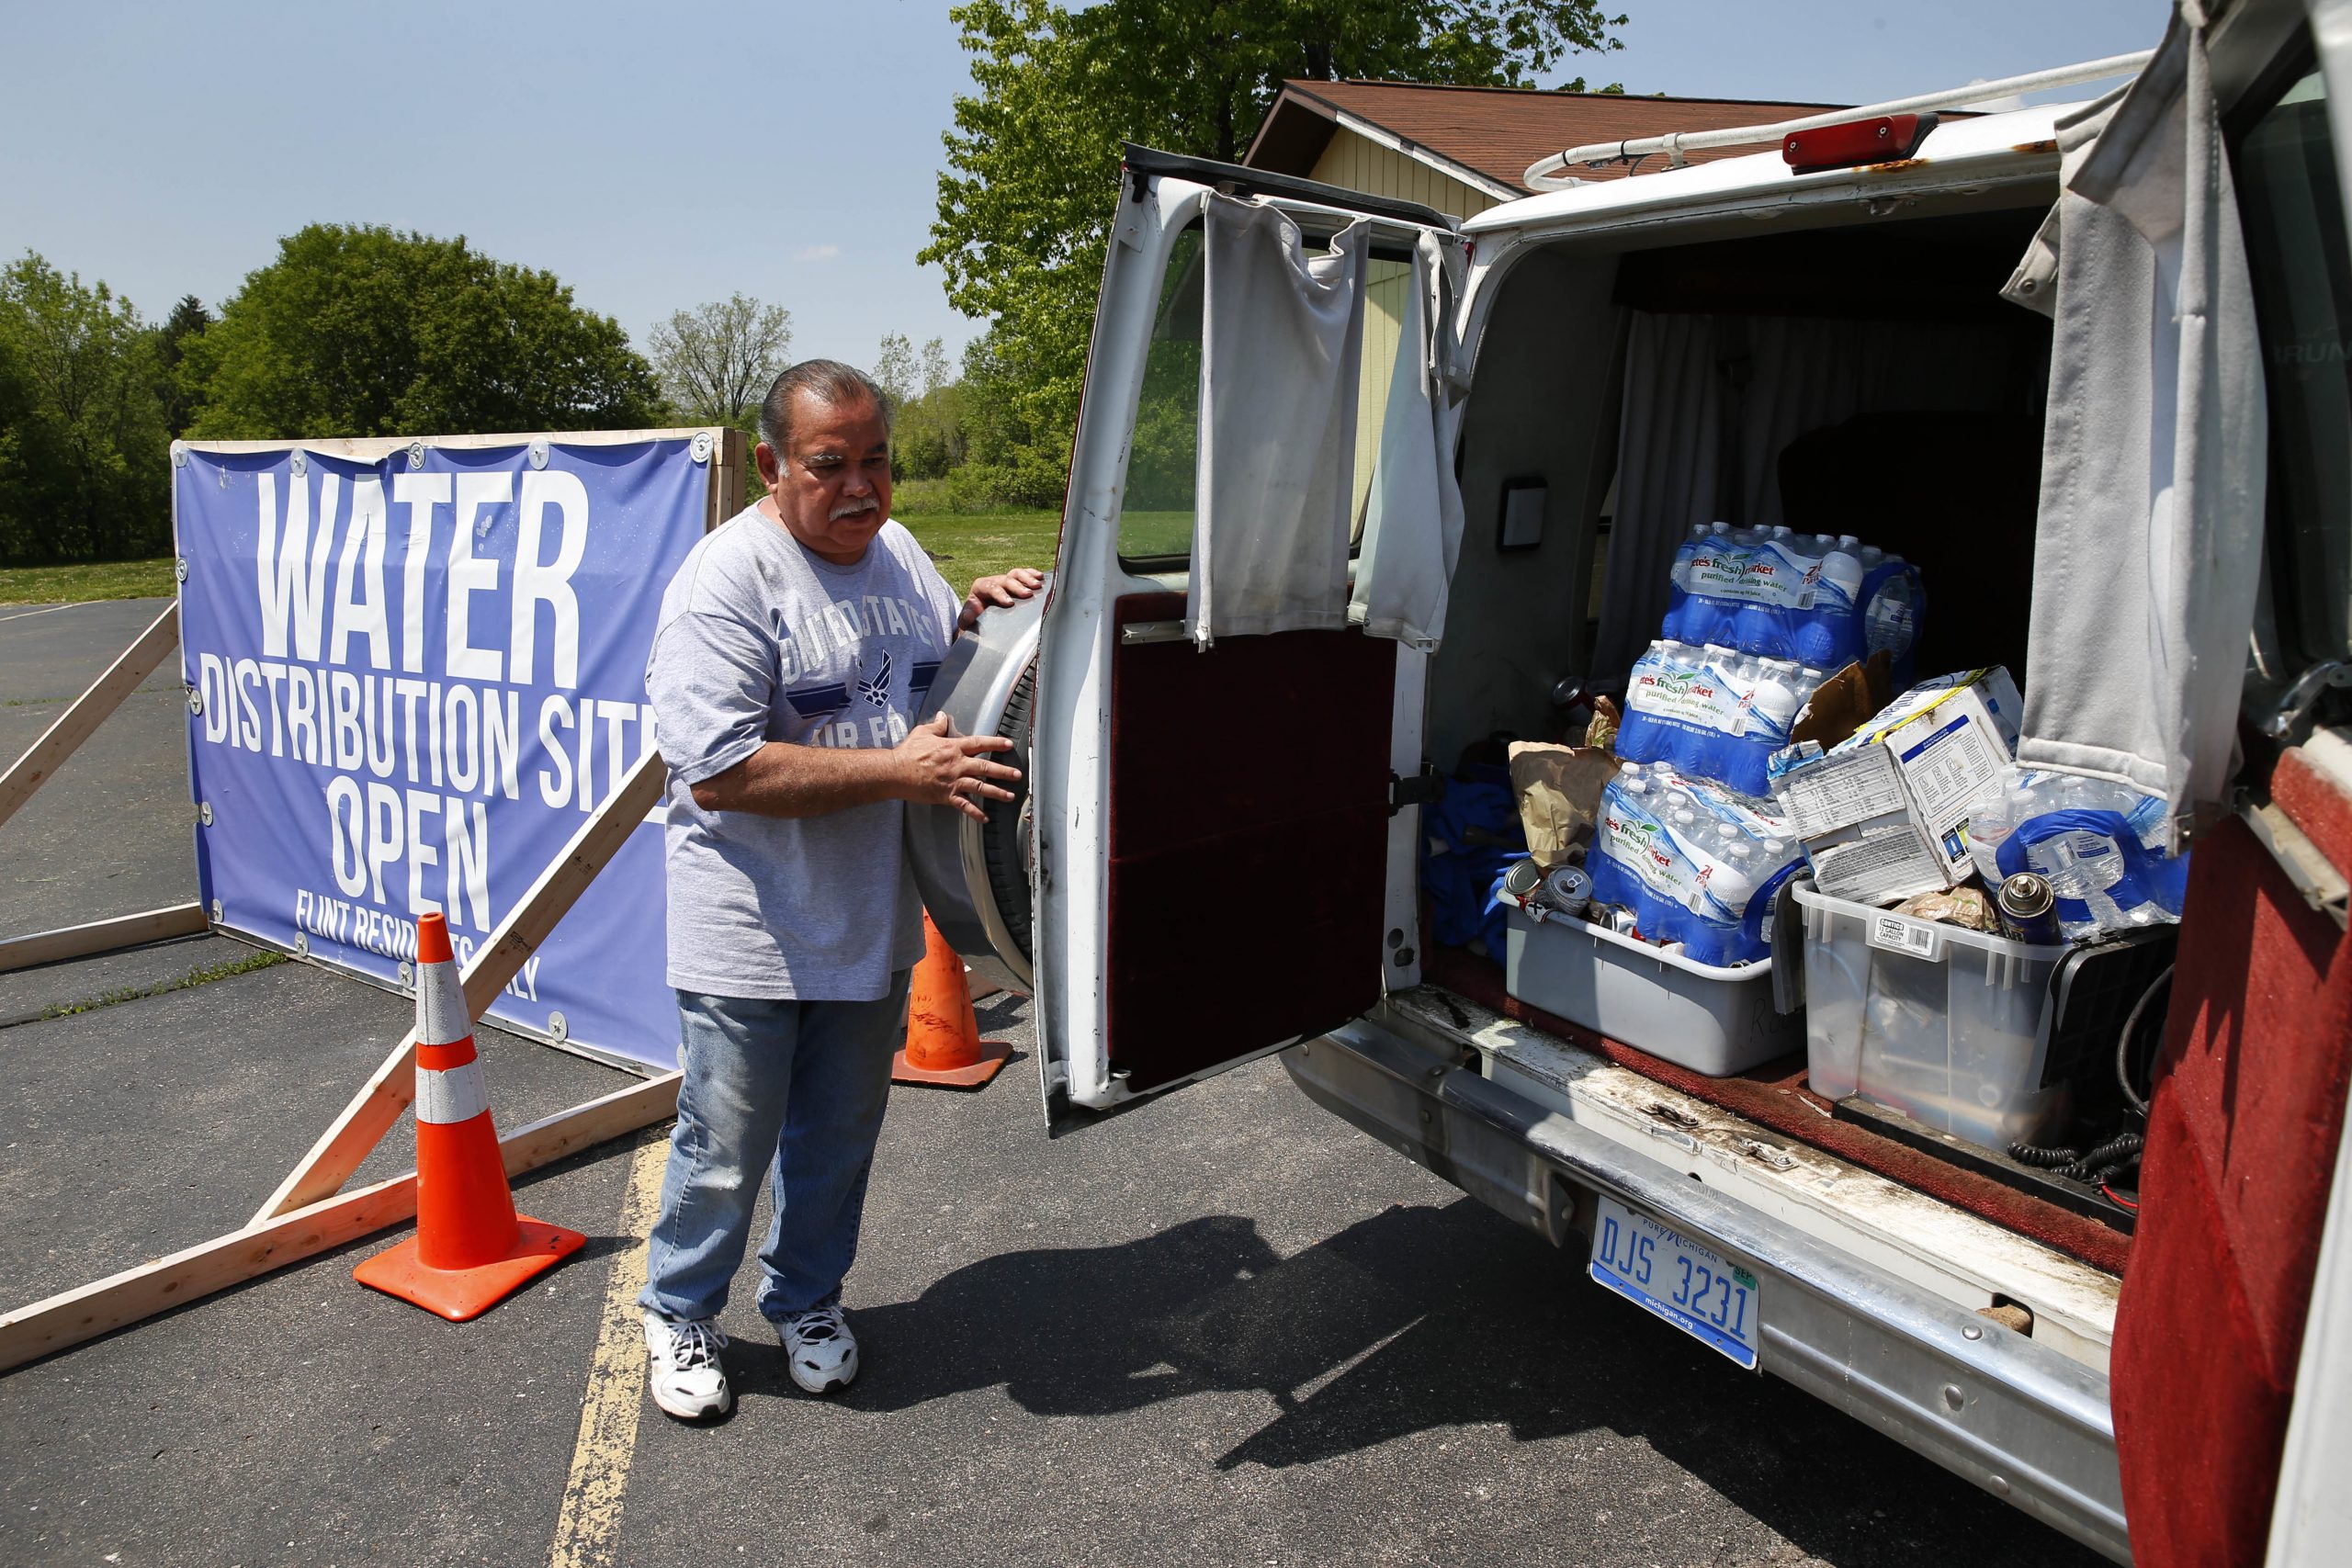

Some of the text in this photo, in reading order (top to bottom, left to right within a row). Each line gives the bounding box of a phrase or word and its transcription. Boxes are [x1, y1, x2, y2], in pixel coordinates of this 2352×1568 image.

[1713, 558, 1742, 575] fresh
[258, 470, 589, 690] WATER
[1701, 571, 1734, 583] purified
[1763, 580, 1788, 592] water
[1657, 677, 1685, 694] fresh
[1645, 690, 1677, 704] purified
[1702, 703, 1724, 716] water
[199, 653, 520, 801] DISTRIBUTION
[1621, 823, 1647, 848] fresh
[326, 775, 491, 933] OPEN
[1610, 835, 1639, 854] purified
[1658, 870, 1682, 886] water
[1700, 864, 1713, 880] 24
[1879, 931, 1902, 942] CAPACITY
[1880, 919, 1904, 931] CONTICO
[1884, 927, 1904, 937] GALLON
[296, 888, 351, 944] FLINT
[353, 906, 473, 967] RESIDTS
[505, 956, 540, 1002] LY
[1643, 1219, 1718, 1263] PURE MICHIGAN
[1600, 1216, 1747, 1340] DJS 3231
[1735, 1266, 1753, 1280] SEP
[1645, 1296, 1694, 1330] michigan.org
